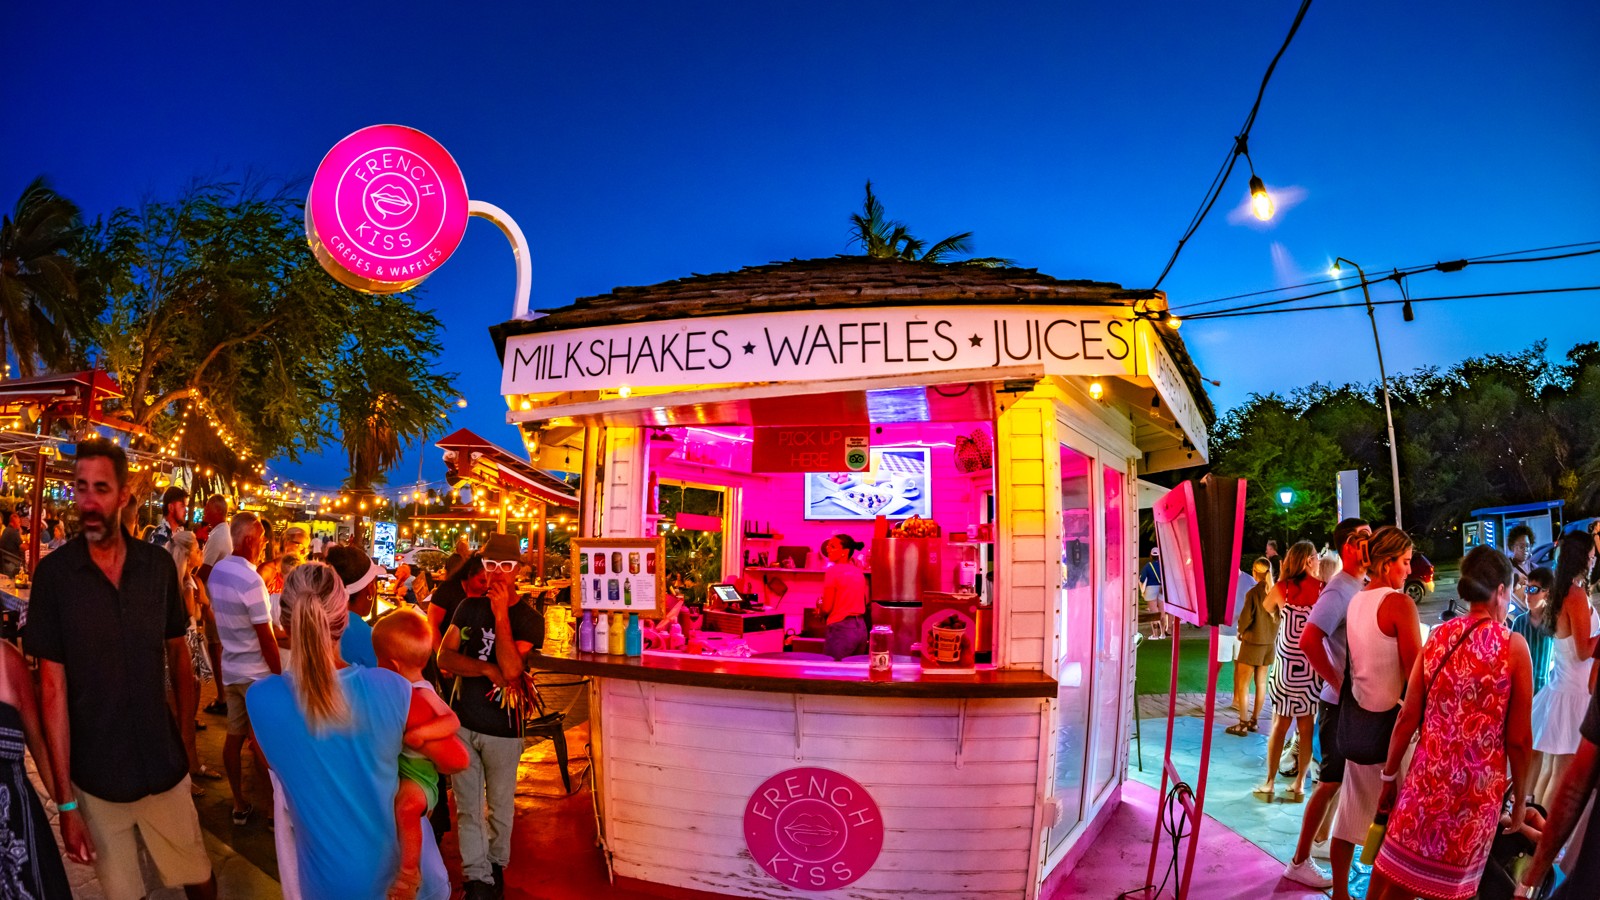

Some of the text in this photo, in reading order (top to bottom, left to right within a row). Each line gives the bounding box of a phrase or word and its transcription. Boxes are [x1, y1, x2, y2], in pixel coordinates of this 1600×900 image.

[354, 153, 436, 197] FRENCH
[355, 221, 412, 250] KISS
[376, 266, 384, 276] &
[389, 247, 442, 276] WAFFLES
[511, 319, 1130, 382] MILKSHAKES WAFFLES JUICES
[778, 430, 843, 446] PICK UP
[791, 452, 829, 467] HERE
[752, 775, 874, 827] FRENCH
[766, 852, 852, 886] KISS
